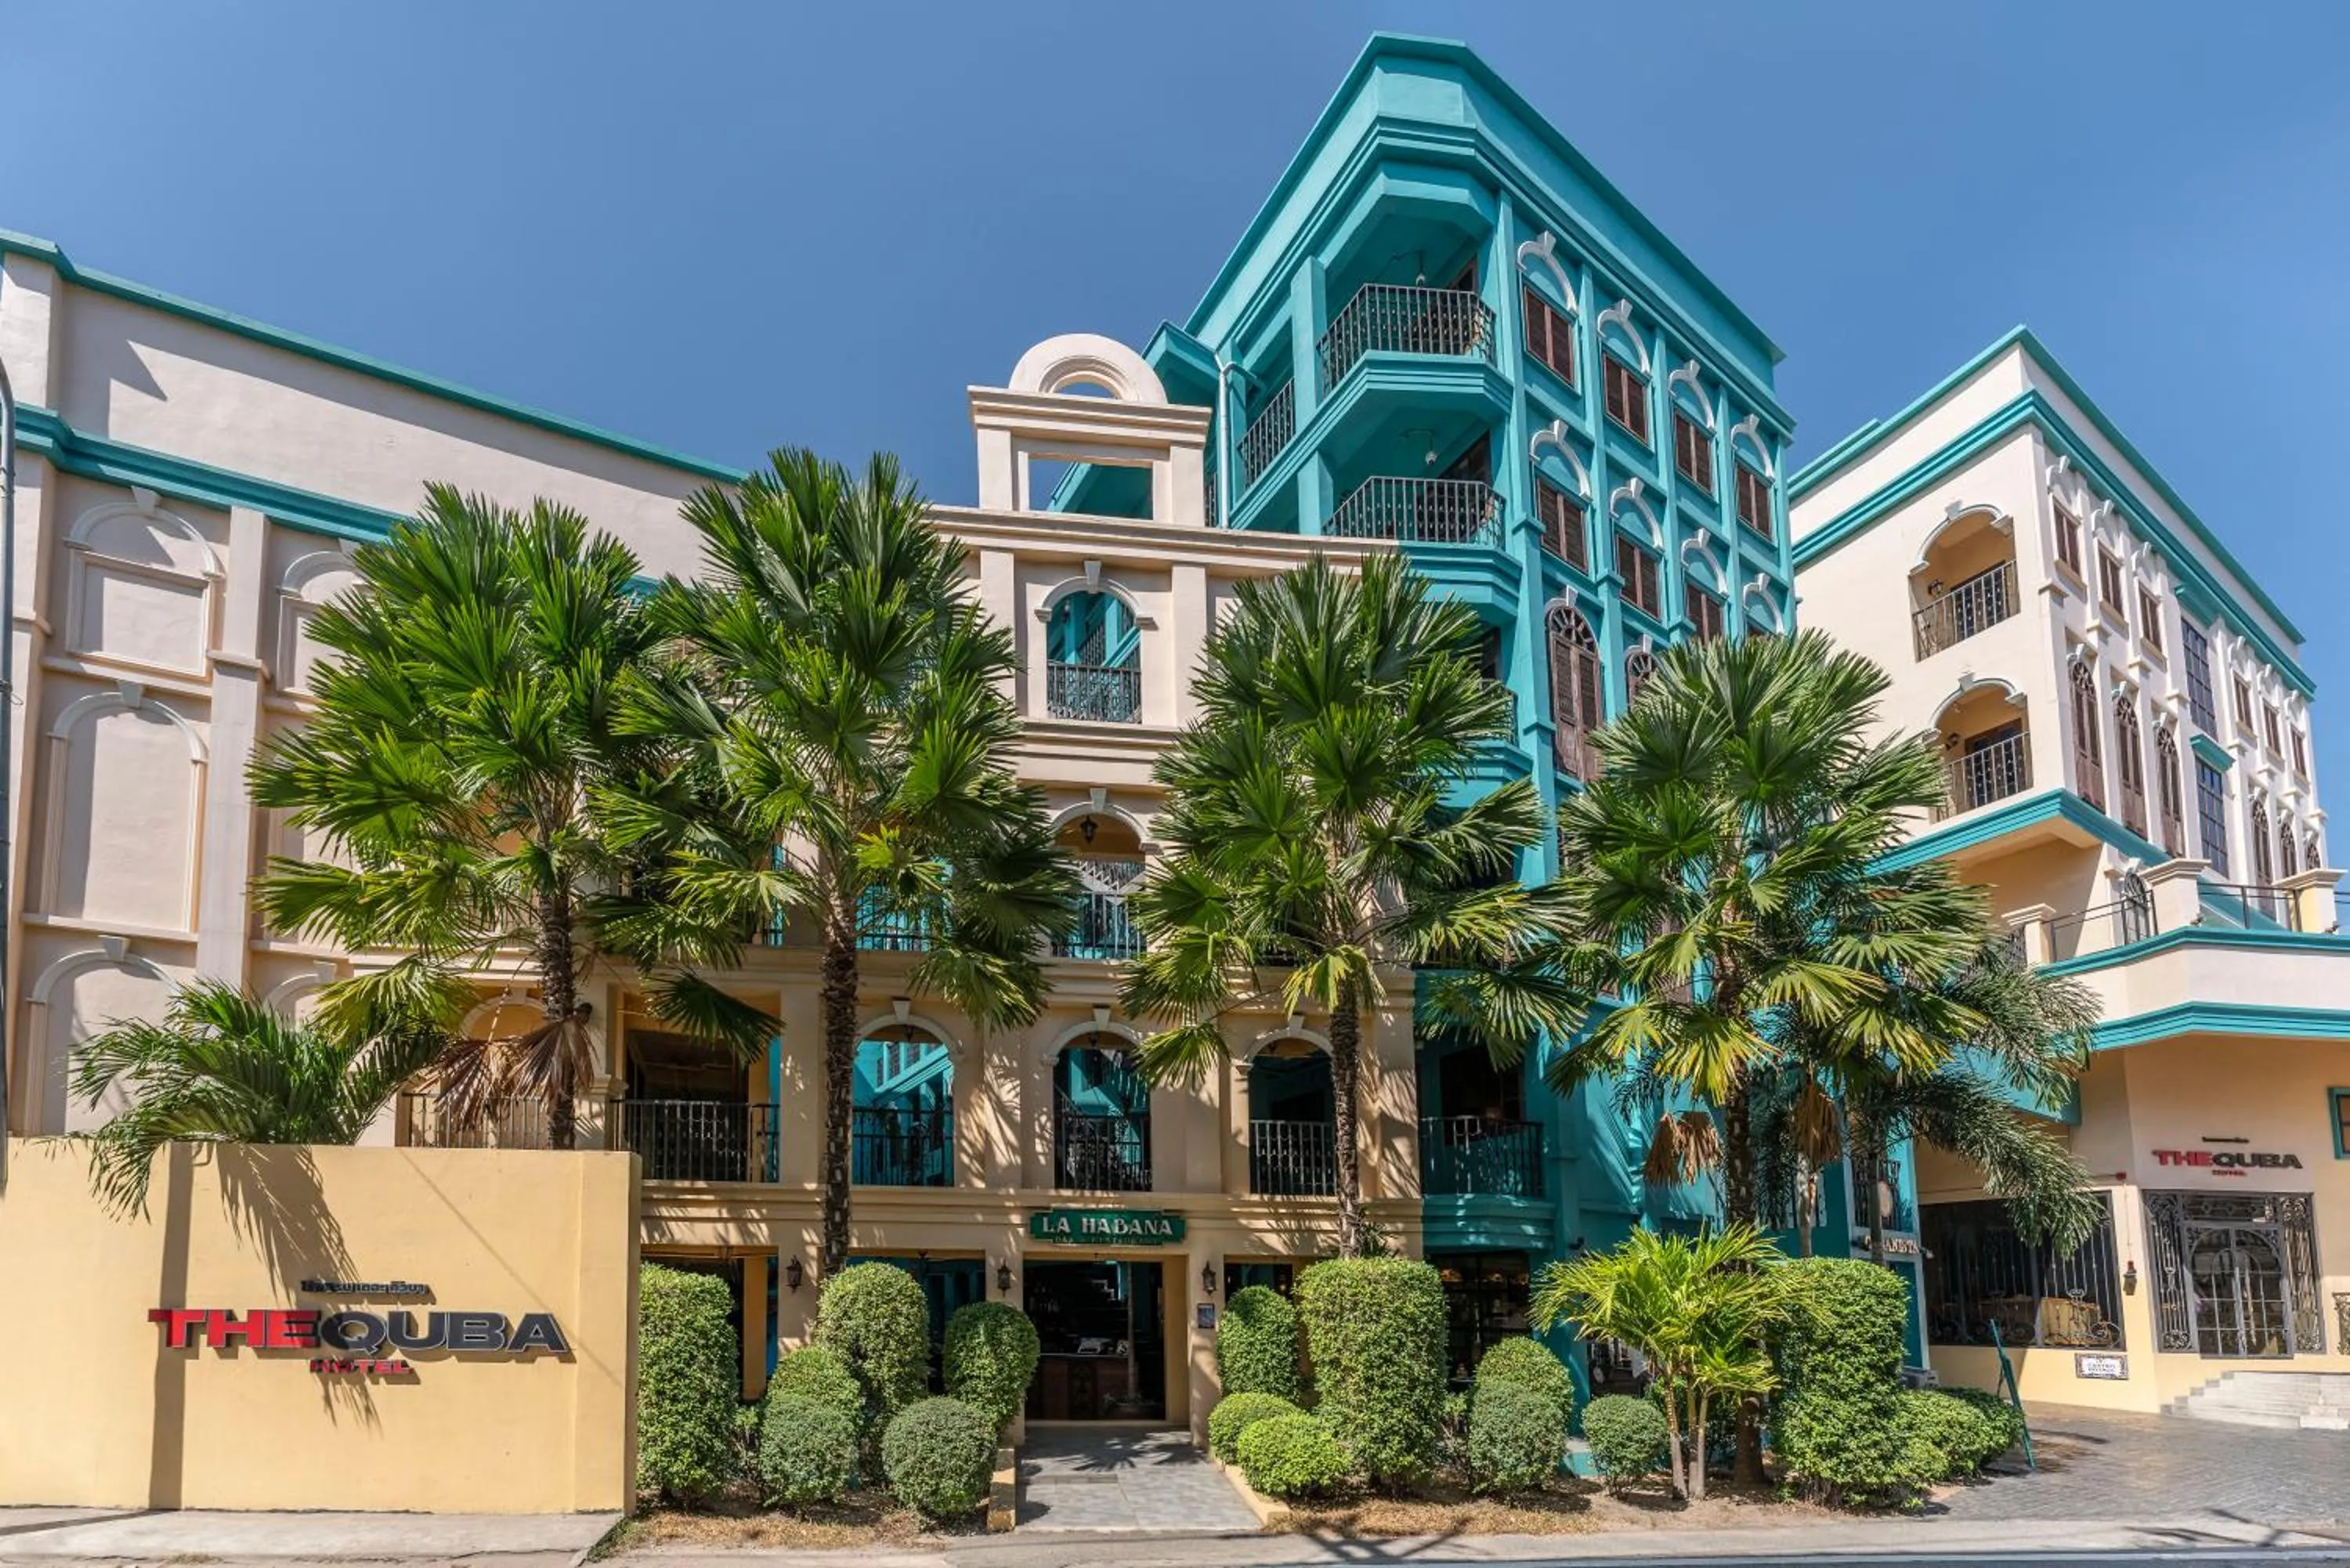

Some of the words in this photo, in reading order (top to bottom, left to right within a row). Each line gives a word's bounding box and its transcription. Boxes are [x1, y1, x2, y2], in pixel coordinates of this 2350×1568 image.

[1043, 1216, 1071, 1234] LA
[1082, 1218, 1173, 1235] HABANA
[310, 1359, 411, 1375] HOTEL
